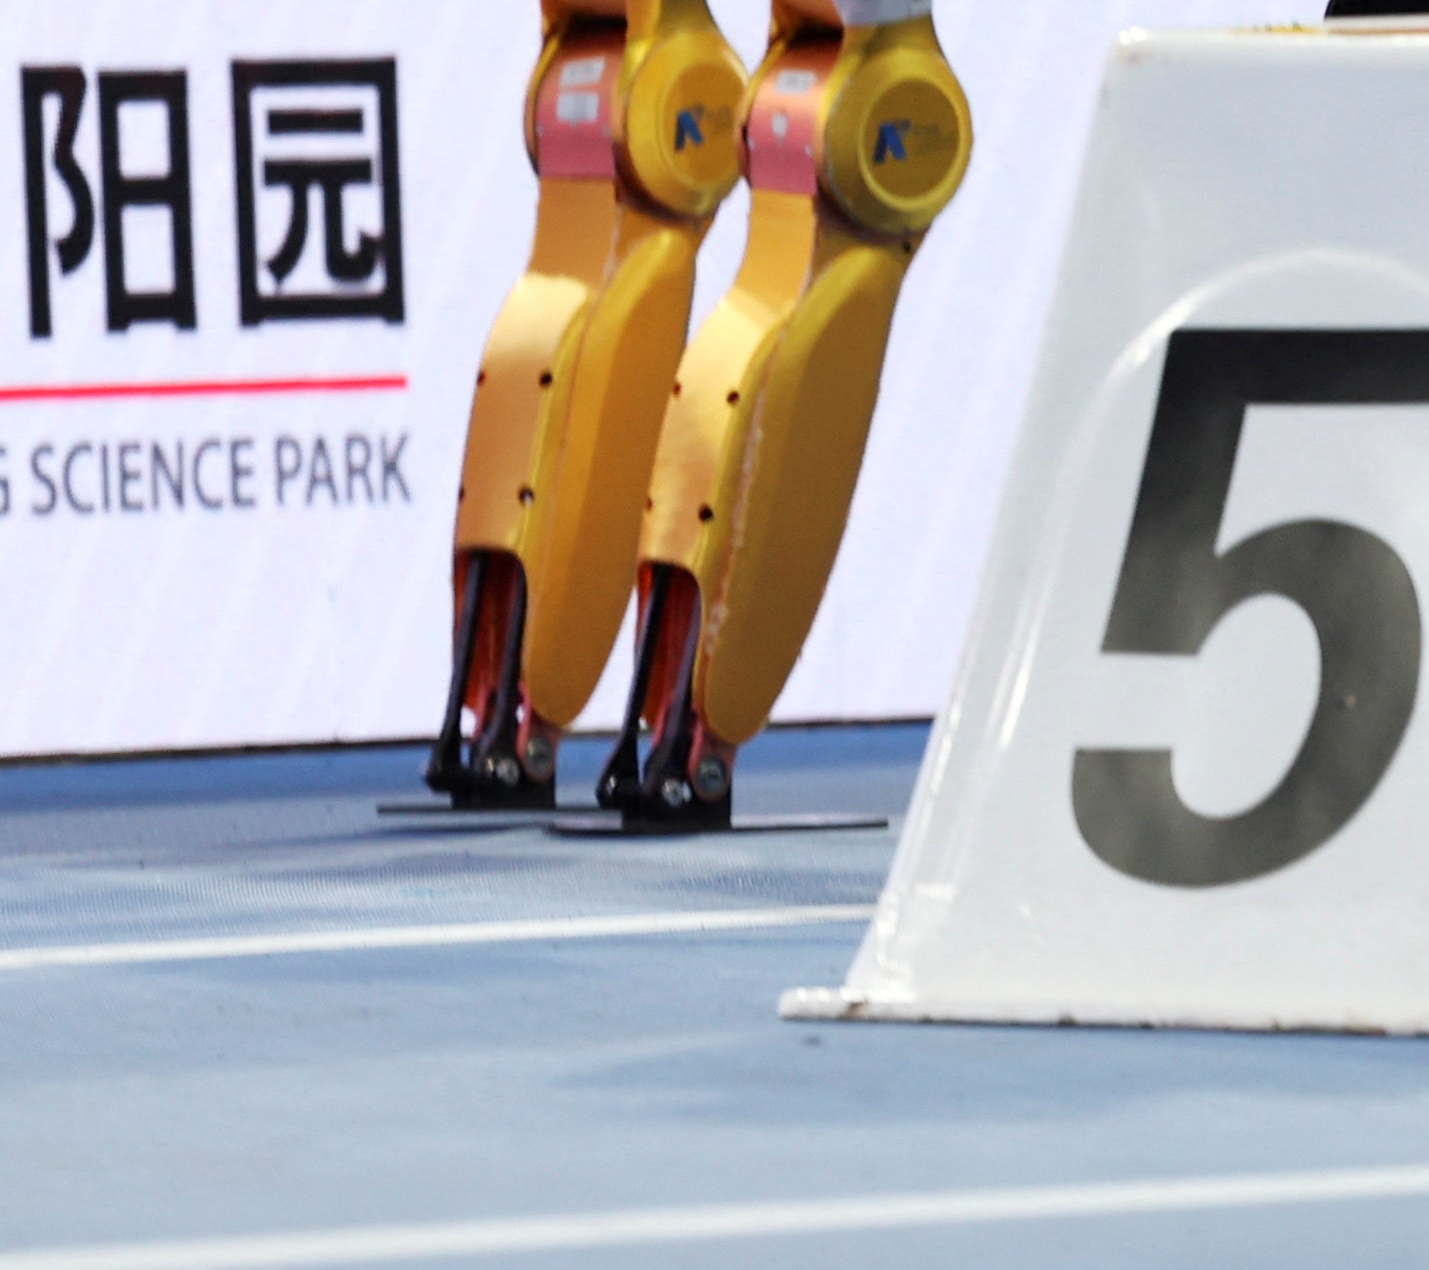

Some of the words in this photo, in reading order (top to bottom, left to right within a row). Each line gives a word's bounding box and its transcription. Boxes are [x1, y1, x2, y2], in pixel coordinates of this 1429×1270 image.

[20, 56, 406, 341] 阳园
[30, 437, 257, 516] SCIENCE
[272, 432, 412, 506] PARK
